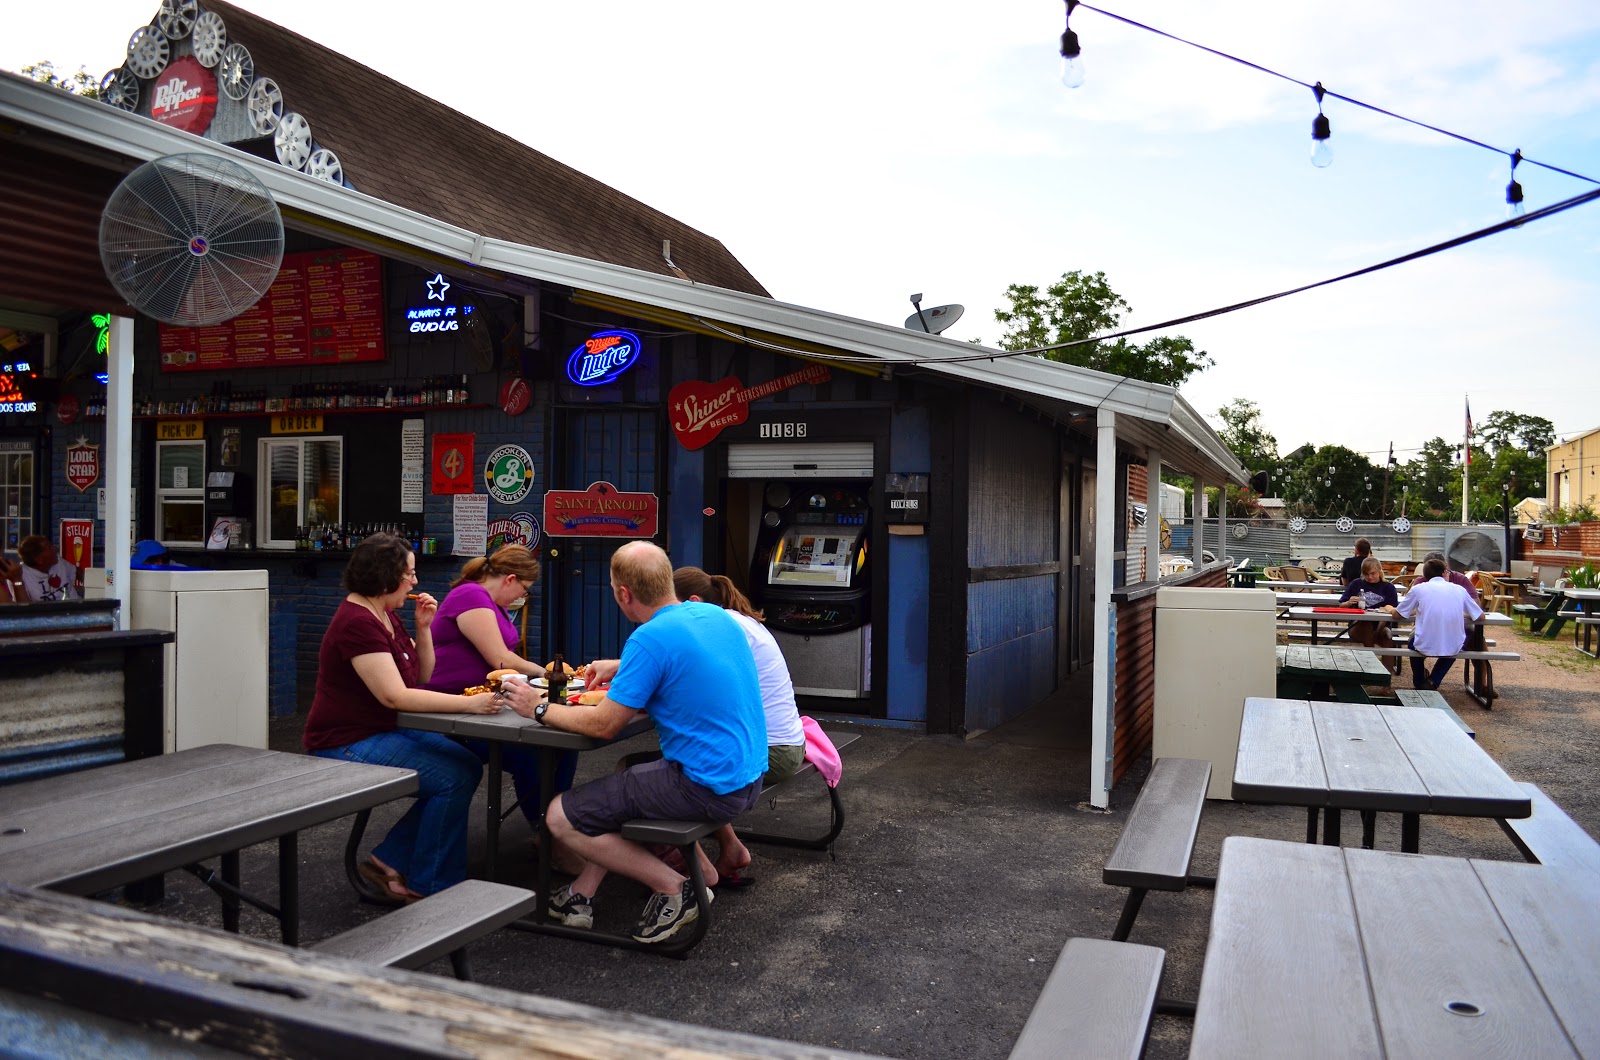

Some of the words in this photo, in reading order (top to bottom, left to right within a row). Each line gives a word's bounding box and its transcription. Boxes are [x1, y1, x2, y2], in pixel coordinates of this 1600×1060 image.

[169, 78, 187, 95] Dr
[154, 85, 201, 112] Pepper
[407, 309, 442, 319] ALWAYS
[586, 336, 621, 354] Miller
[580, 345, 631, 381] Lite
[735, 379, 783, 404] REFRESHINGLY
[784, 364, 828, 387] INDEPENDENT
[15, 402, 36, 412] EQUIS
[675, 386, 738, 432] Shiner
[279, 415, 318, 431] ORDER
[710, 413, 739, 429] BEERS
[162, 423, 197, 438] PICK-UP
[761, 423, 806, 437] 1133
[70, 450, 95, 463] LONE
[490, 446, 529, 465] BROOKLYN
[69, 464, 95, 477] STAR
[491, 486, 527, 501] BREWERY
[554, 496, 593, 510] SAINT
[593, 498, 648, 515] ARNOLD
[891, 499, 918, 509] TOWELS
[571, 516, 602, 525] BREWING
[602, 516, 633, 526] COMPANY
[66, 524, 91, 537] STELLA
[662, 908, 674, 918] N
